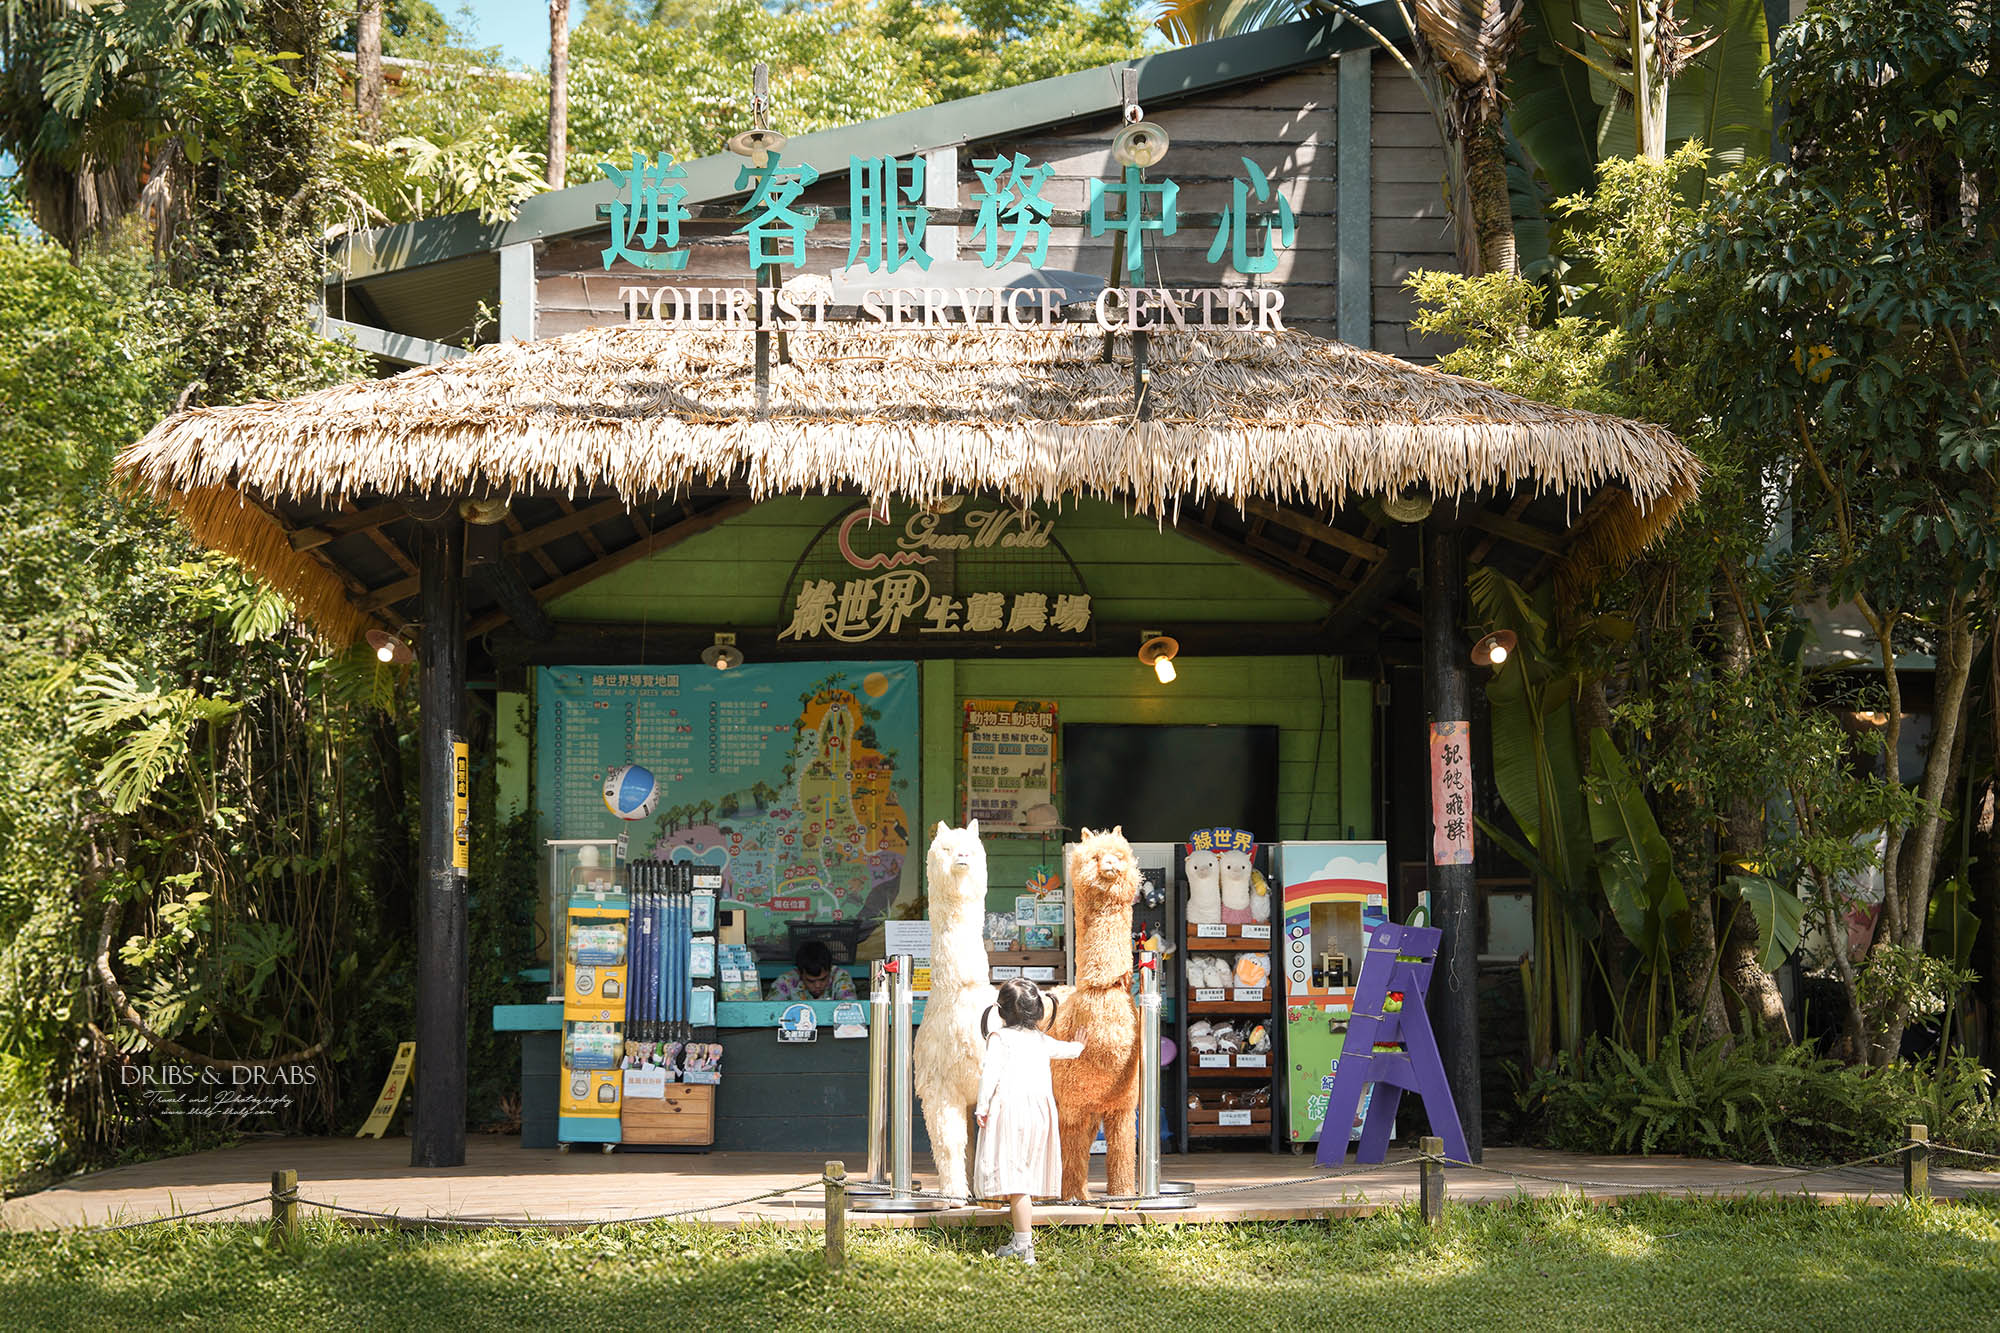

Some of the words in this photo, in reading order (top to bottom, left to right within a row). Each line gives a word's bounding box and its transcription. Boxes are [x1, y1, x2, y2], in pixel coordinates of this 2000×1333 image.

[597, 150, 1297, 274] 遊客服務中心
[618, 286, 834, 332] TOURIST
[862, 287, 1068, 332] SERVICE
[1096, 287, 1288, 332] CENTER
[896, 510, 972, 550] Green
[965, 509, 1055, 549] World
[969, 711, 1053, 727] 動物互動時間
[1192, 829, 1252, 852] 綠世界
